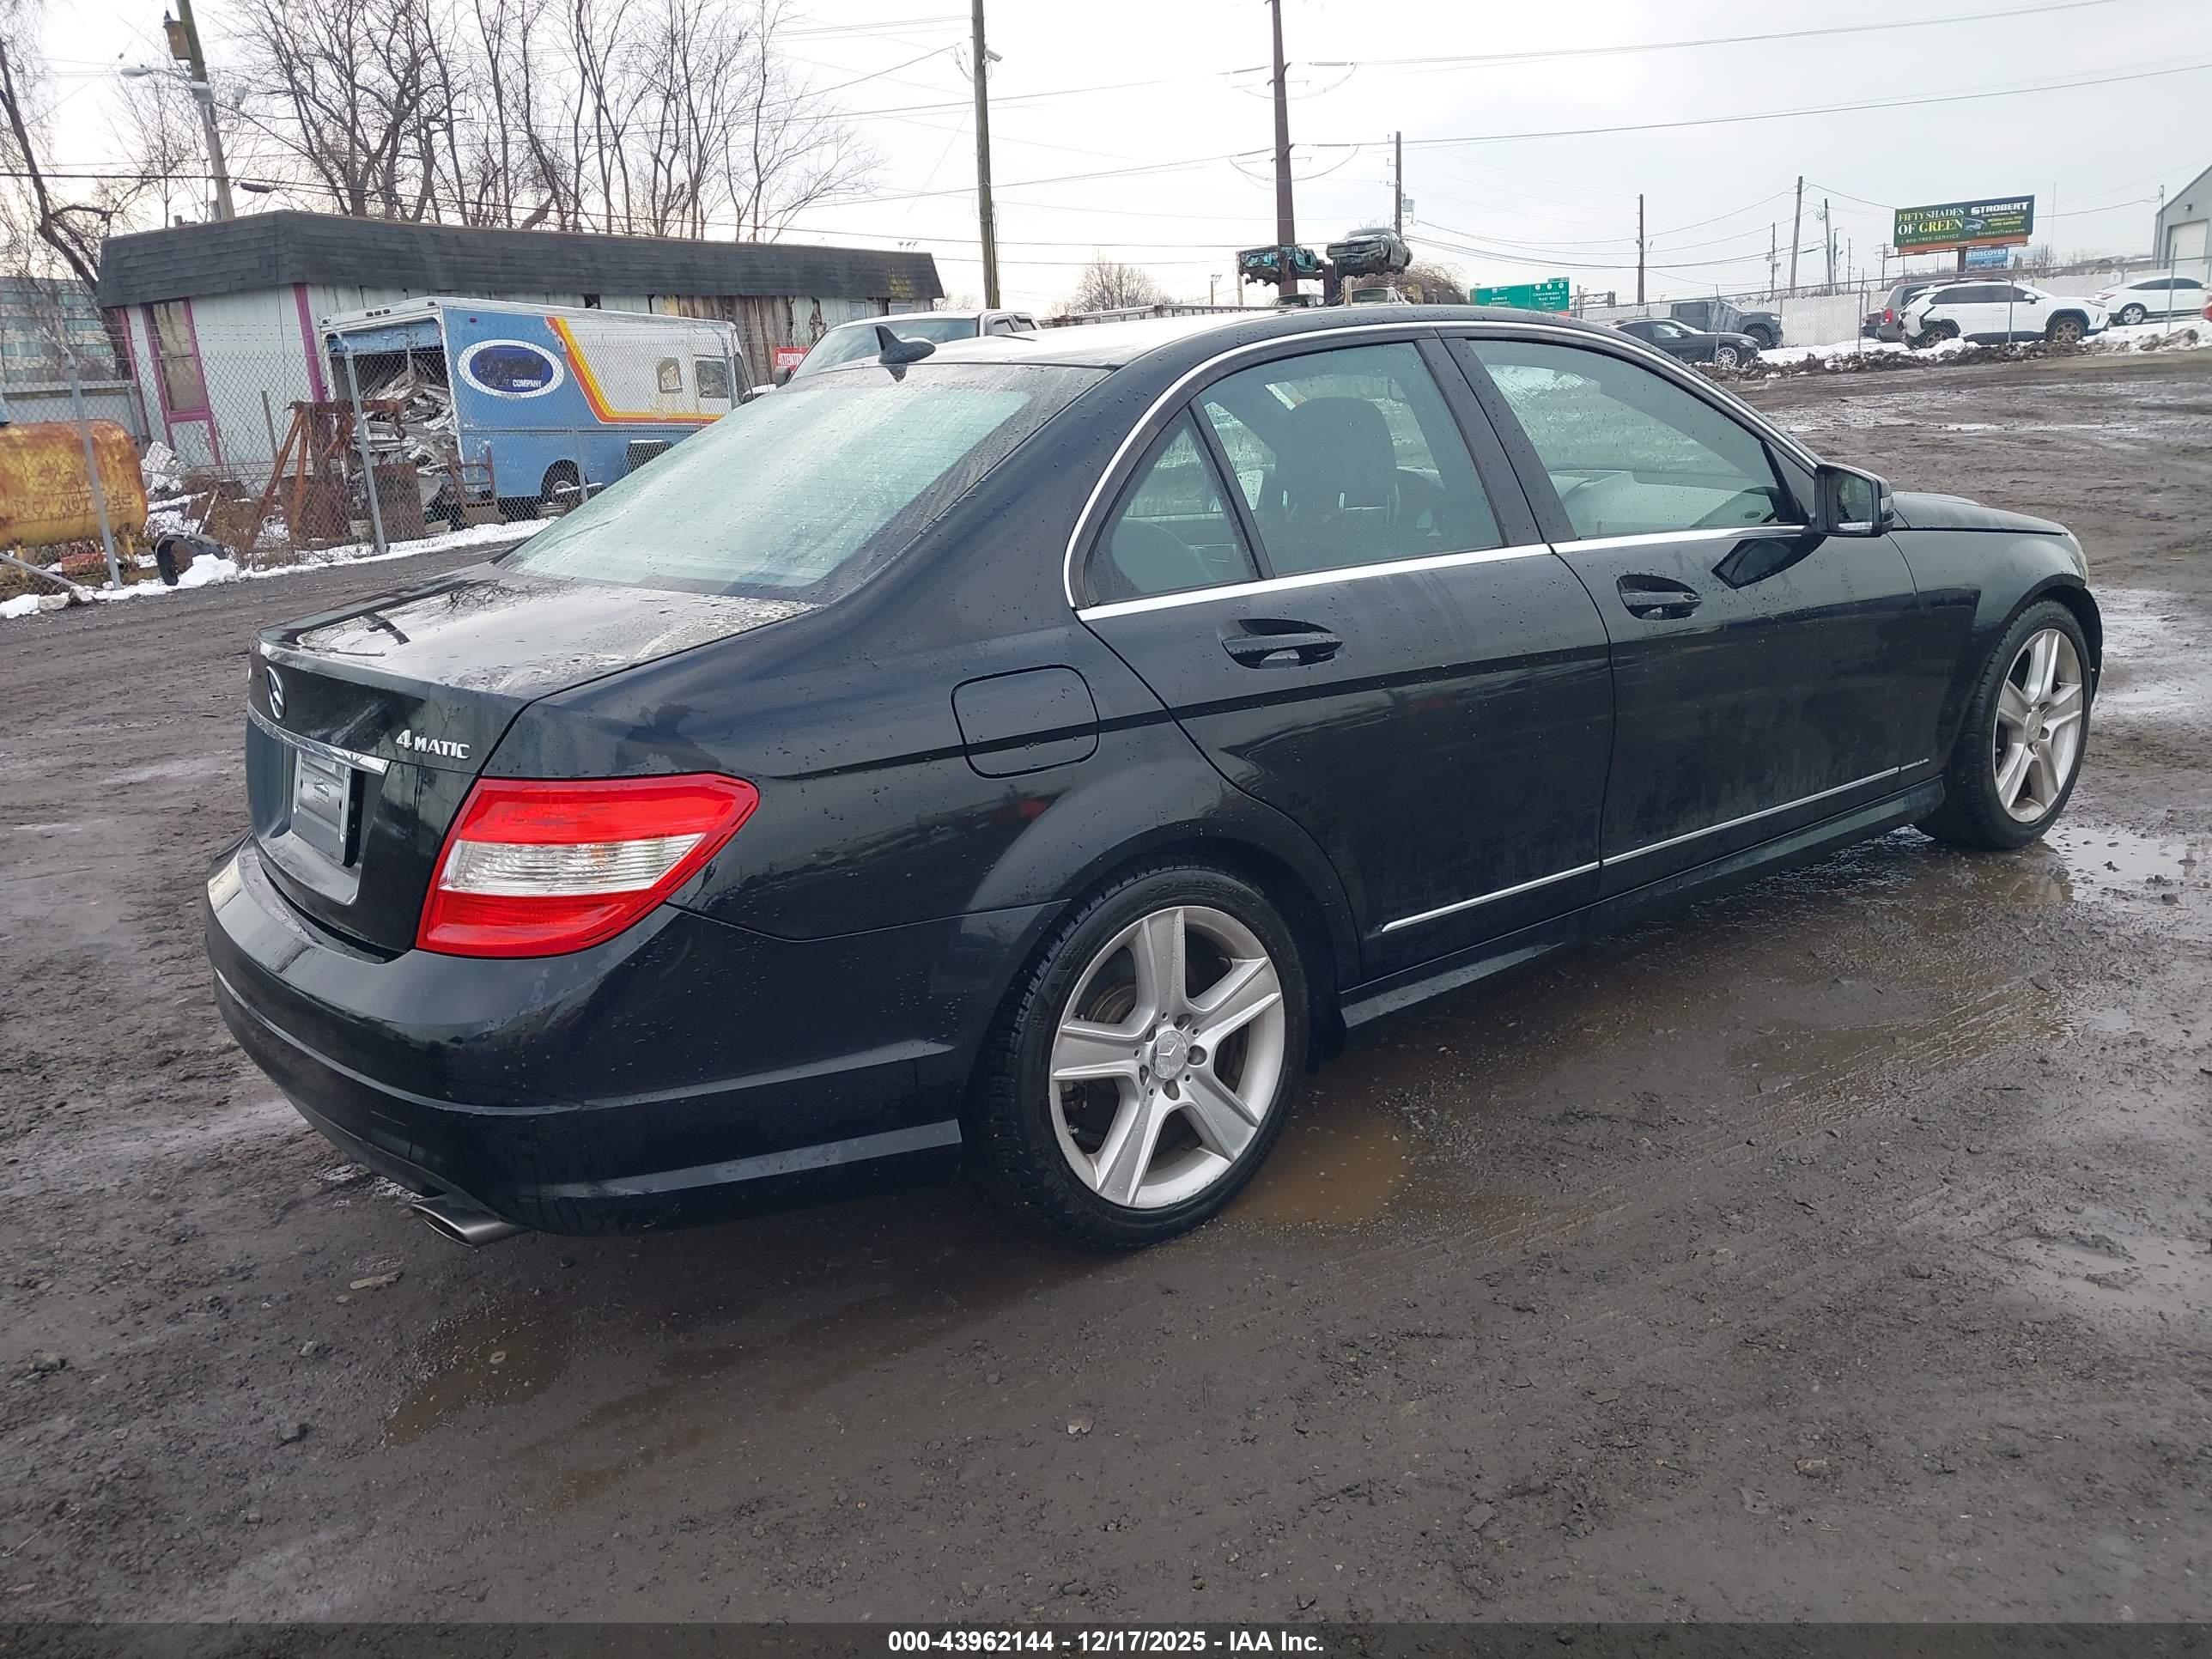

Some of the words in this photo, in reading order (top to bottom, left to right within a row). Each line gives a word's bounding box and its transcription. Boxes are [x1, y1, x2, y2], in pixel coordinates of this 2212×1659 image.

[1898, 212, 1924, 222] FIFTY
[1925, 207, 1965, 219] SHADES
[1971, 201, 2030, 216] STROBERT
[1898, 222, 1917, 235] OF
[1918, 217, 1964, 234] GREEN
[512, 379, 542, 388] COMPANY
